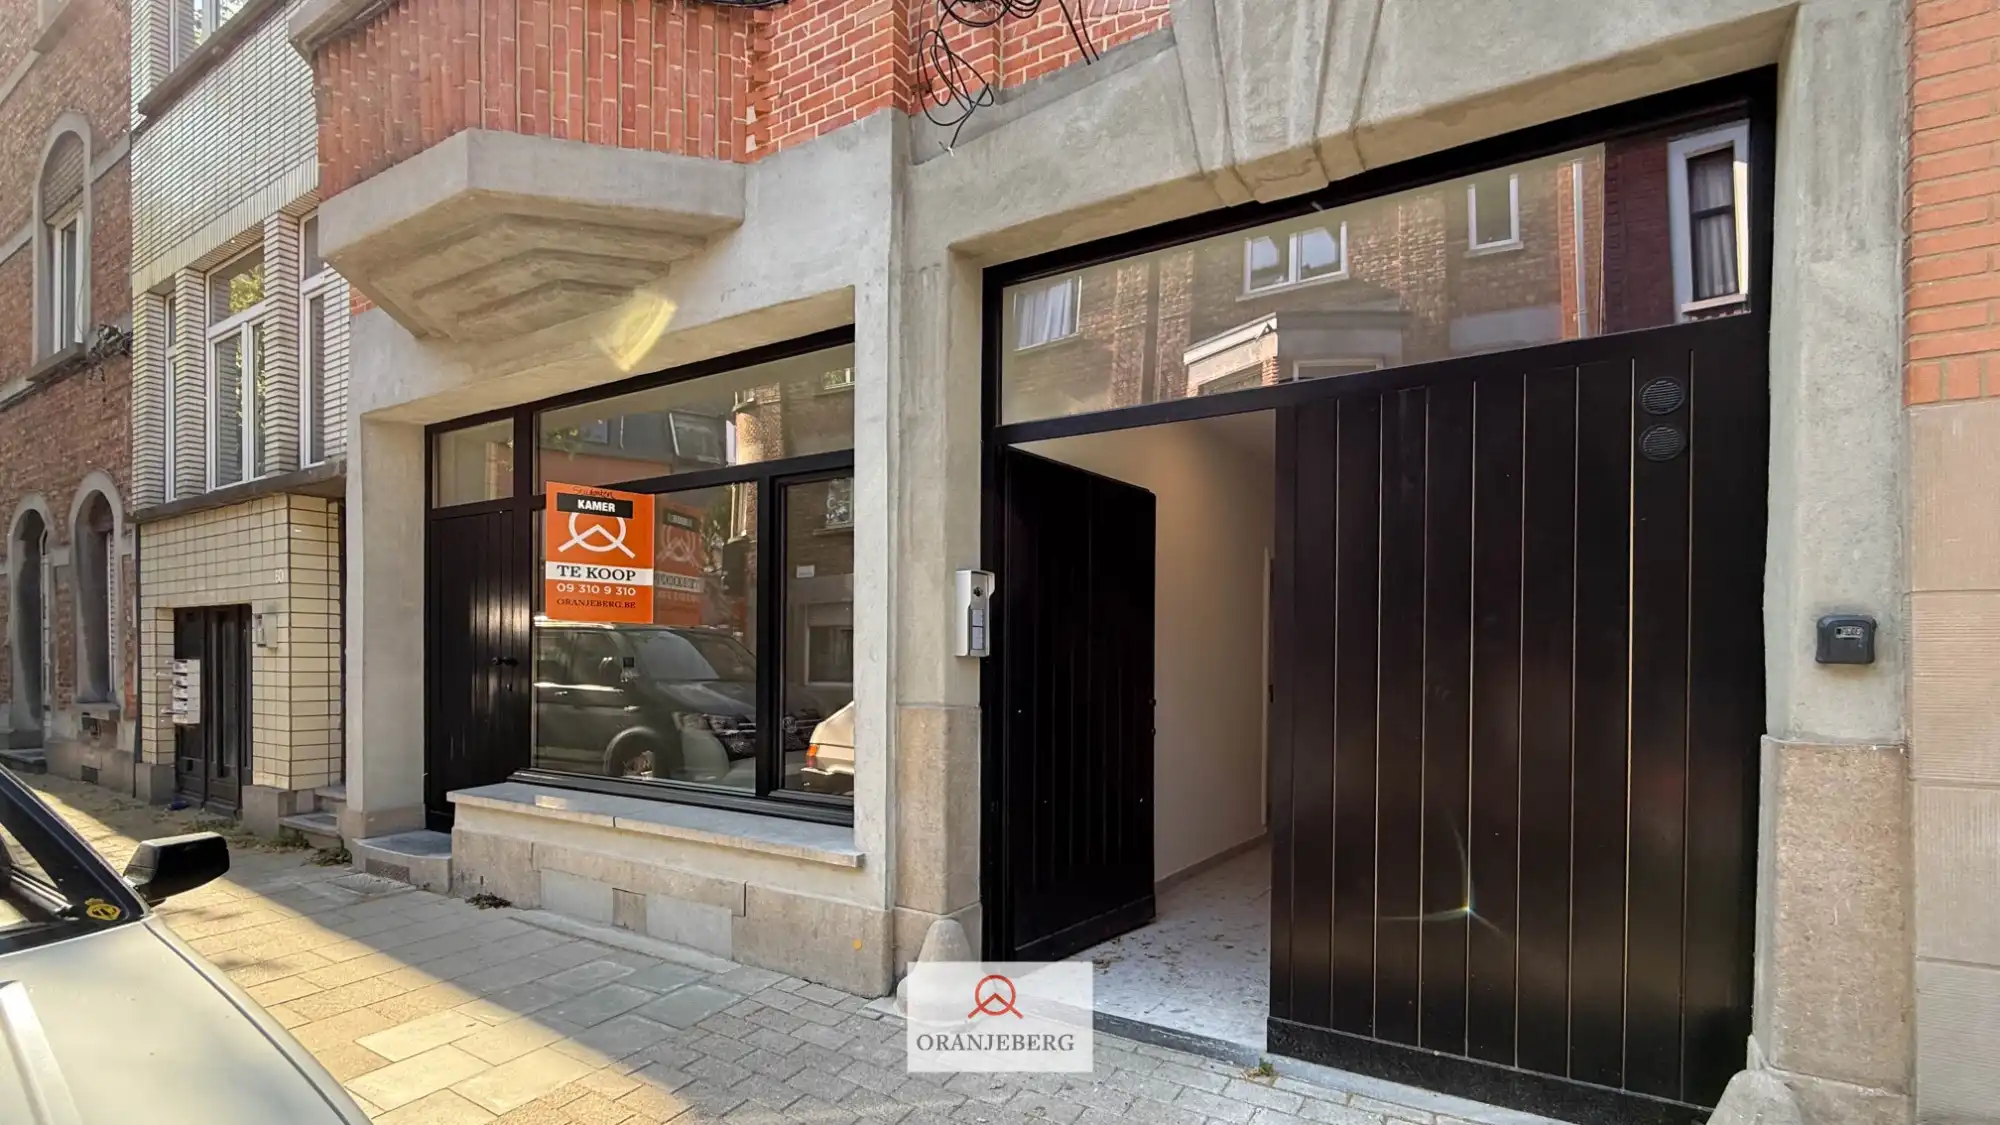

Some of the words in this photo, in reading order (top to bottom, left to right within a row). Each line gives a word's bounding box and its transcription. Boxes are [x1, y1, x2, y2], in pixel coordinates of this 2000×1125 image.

[577, 499, 616, 513] KAMER
[556, 565, 581, 578] TE
[586, 566, 636, 581] KOOP
[556, 582, 574, 593] 09
[578, 584, 600, 595] 310
[603, 585, 612, 595] 9
[615, 586, 637, 596] 310
[556, 598, 636, 609] ORANJEBERG.BE
